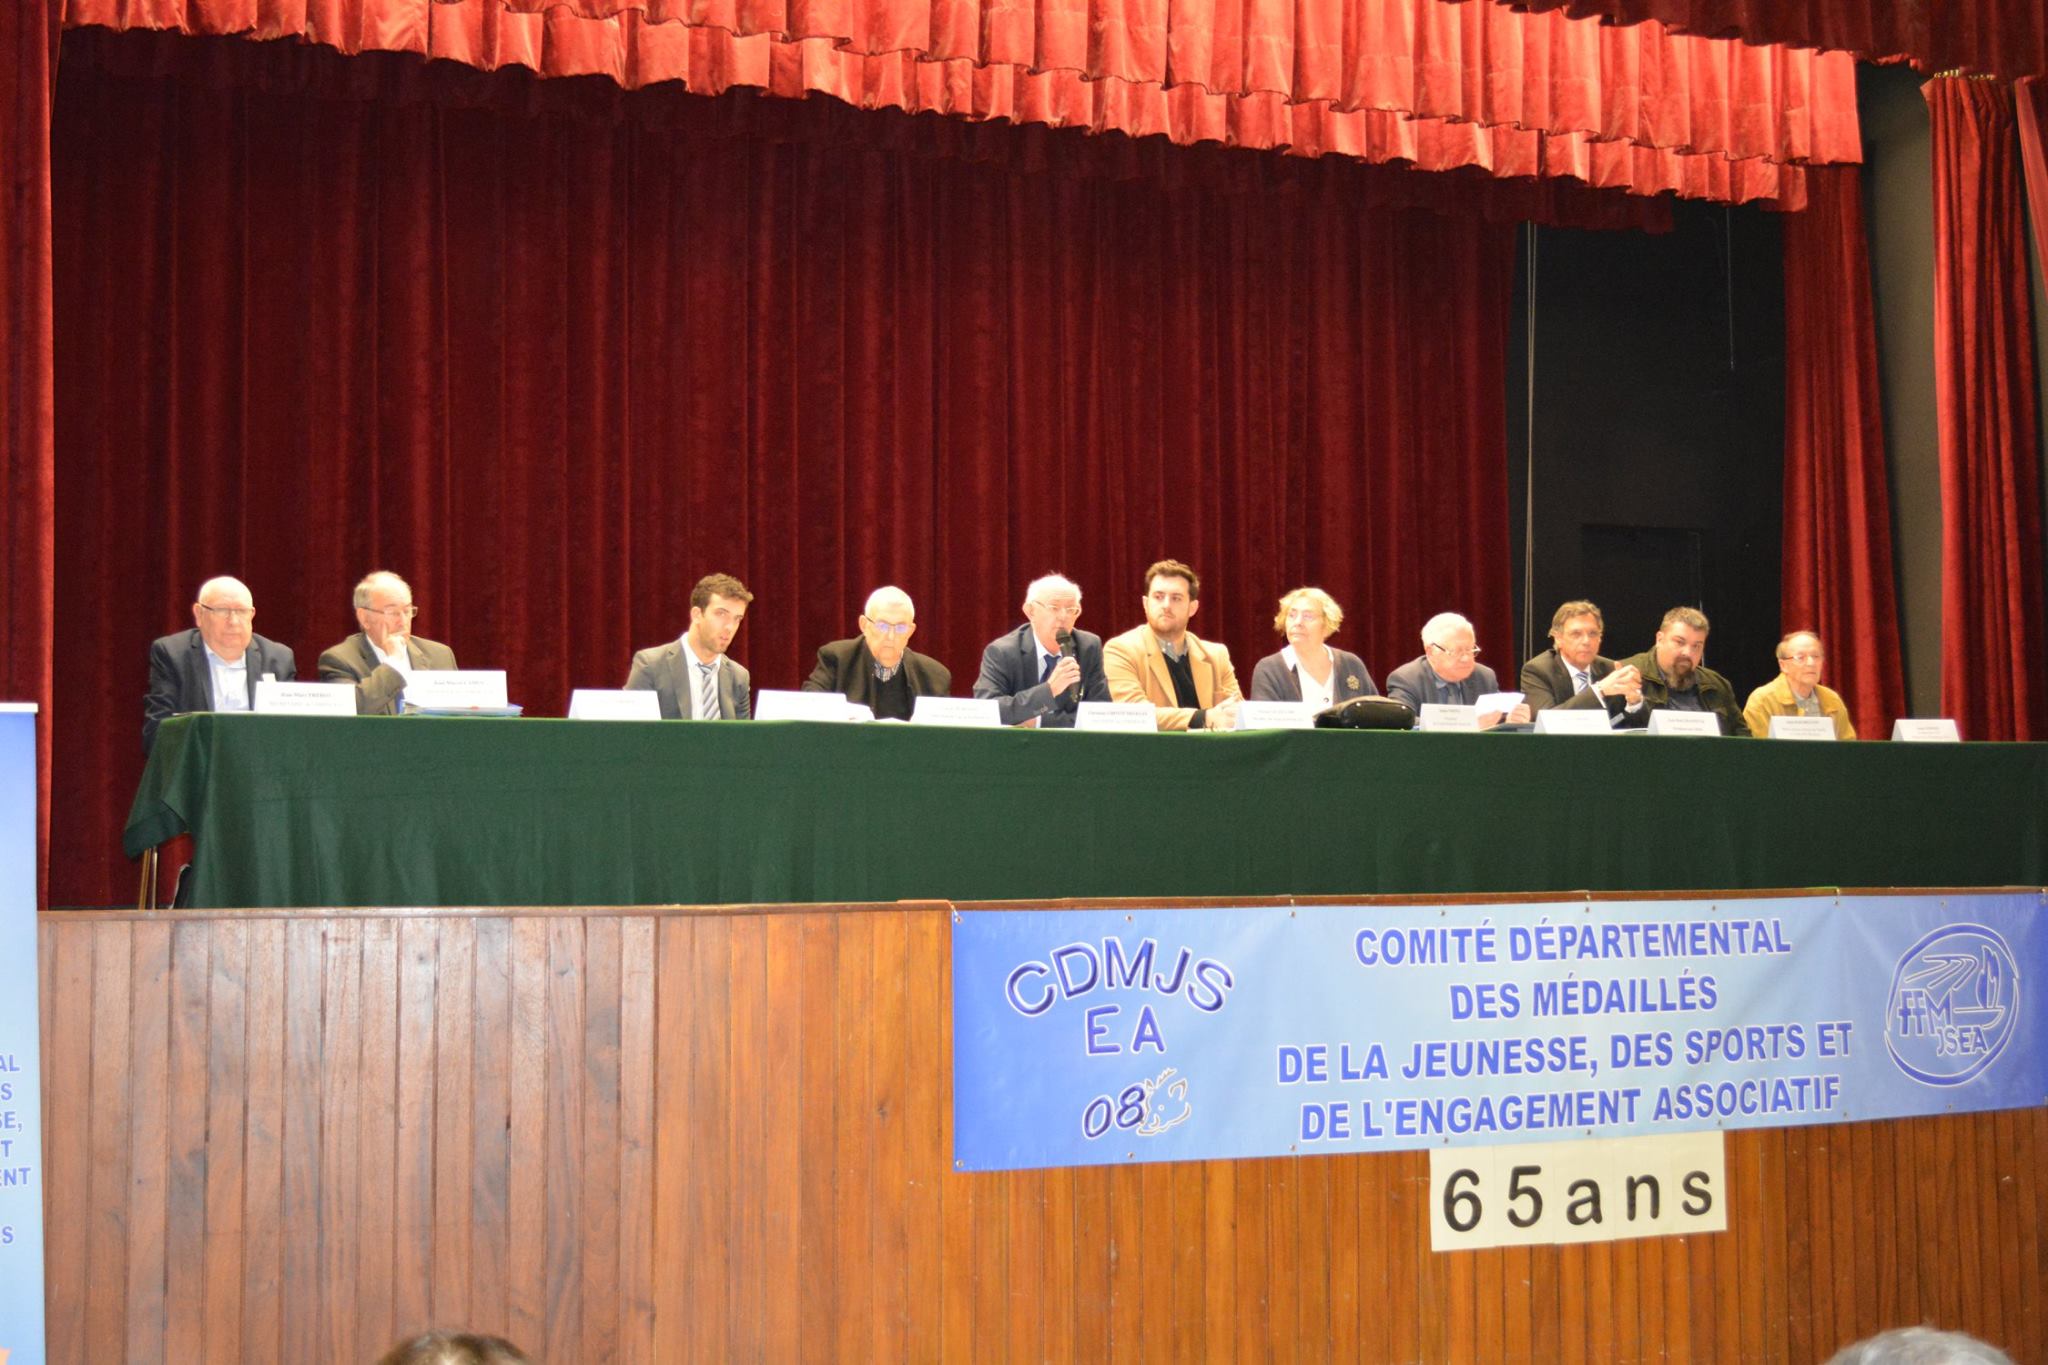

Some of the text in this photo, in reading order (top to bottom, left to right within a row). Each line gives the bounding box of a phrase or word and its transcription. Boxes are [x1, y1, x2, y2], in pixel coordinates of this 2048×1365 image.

[1355, 917, 1792, 966] COMITÉ DÉPARTEMENTAL
[1006, 936, 1234, 1017] CDMJS
[1450, 968, 1718, 1021] DES MÉDAILLÉS
[1278, 1022, 1854, 1084] DE LA JEUNESSE, DES SPORTS ET
[1083, 1081, 1147, 1140] 08
[1301, 1075, 1841, 1141] DE L'ENGAGEMENT ASSOCIATIF
